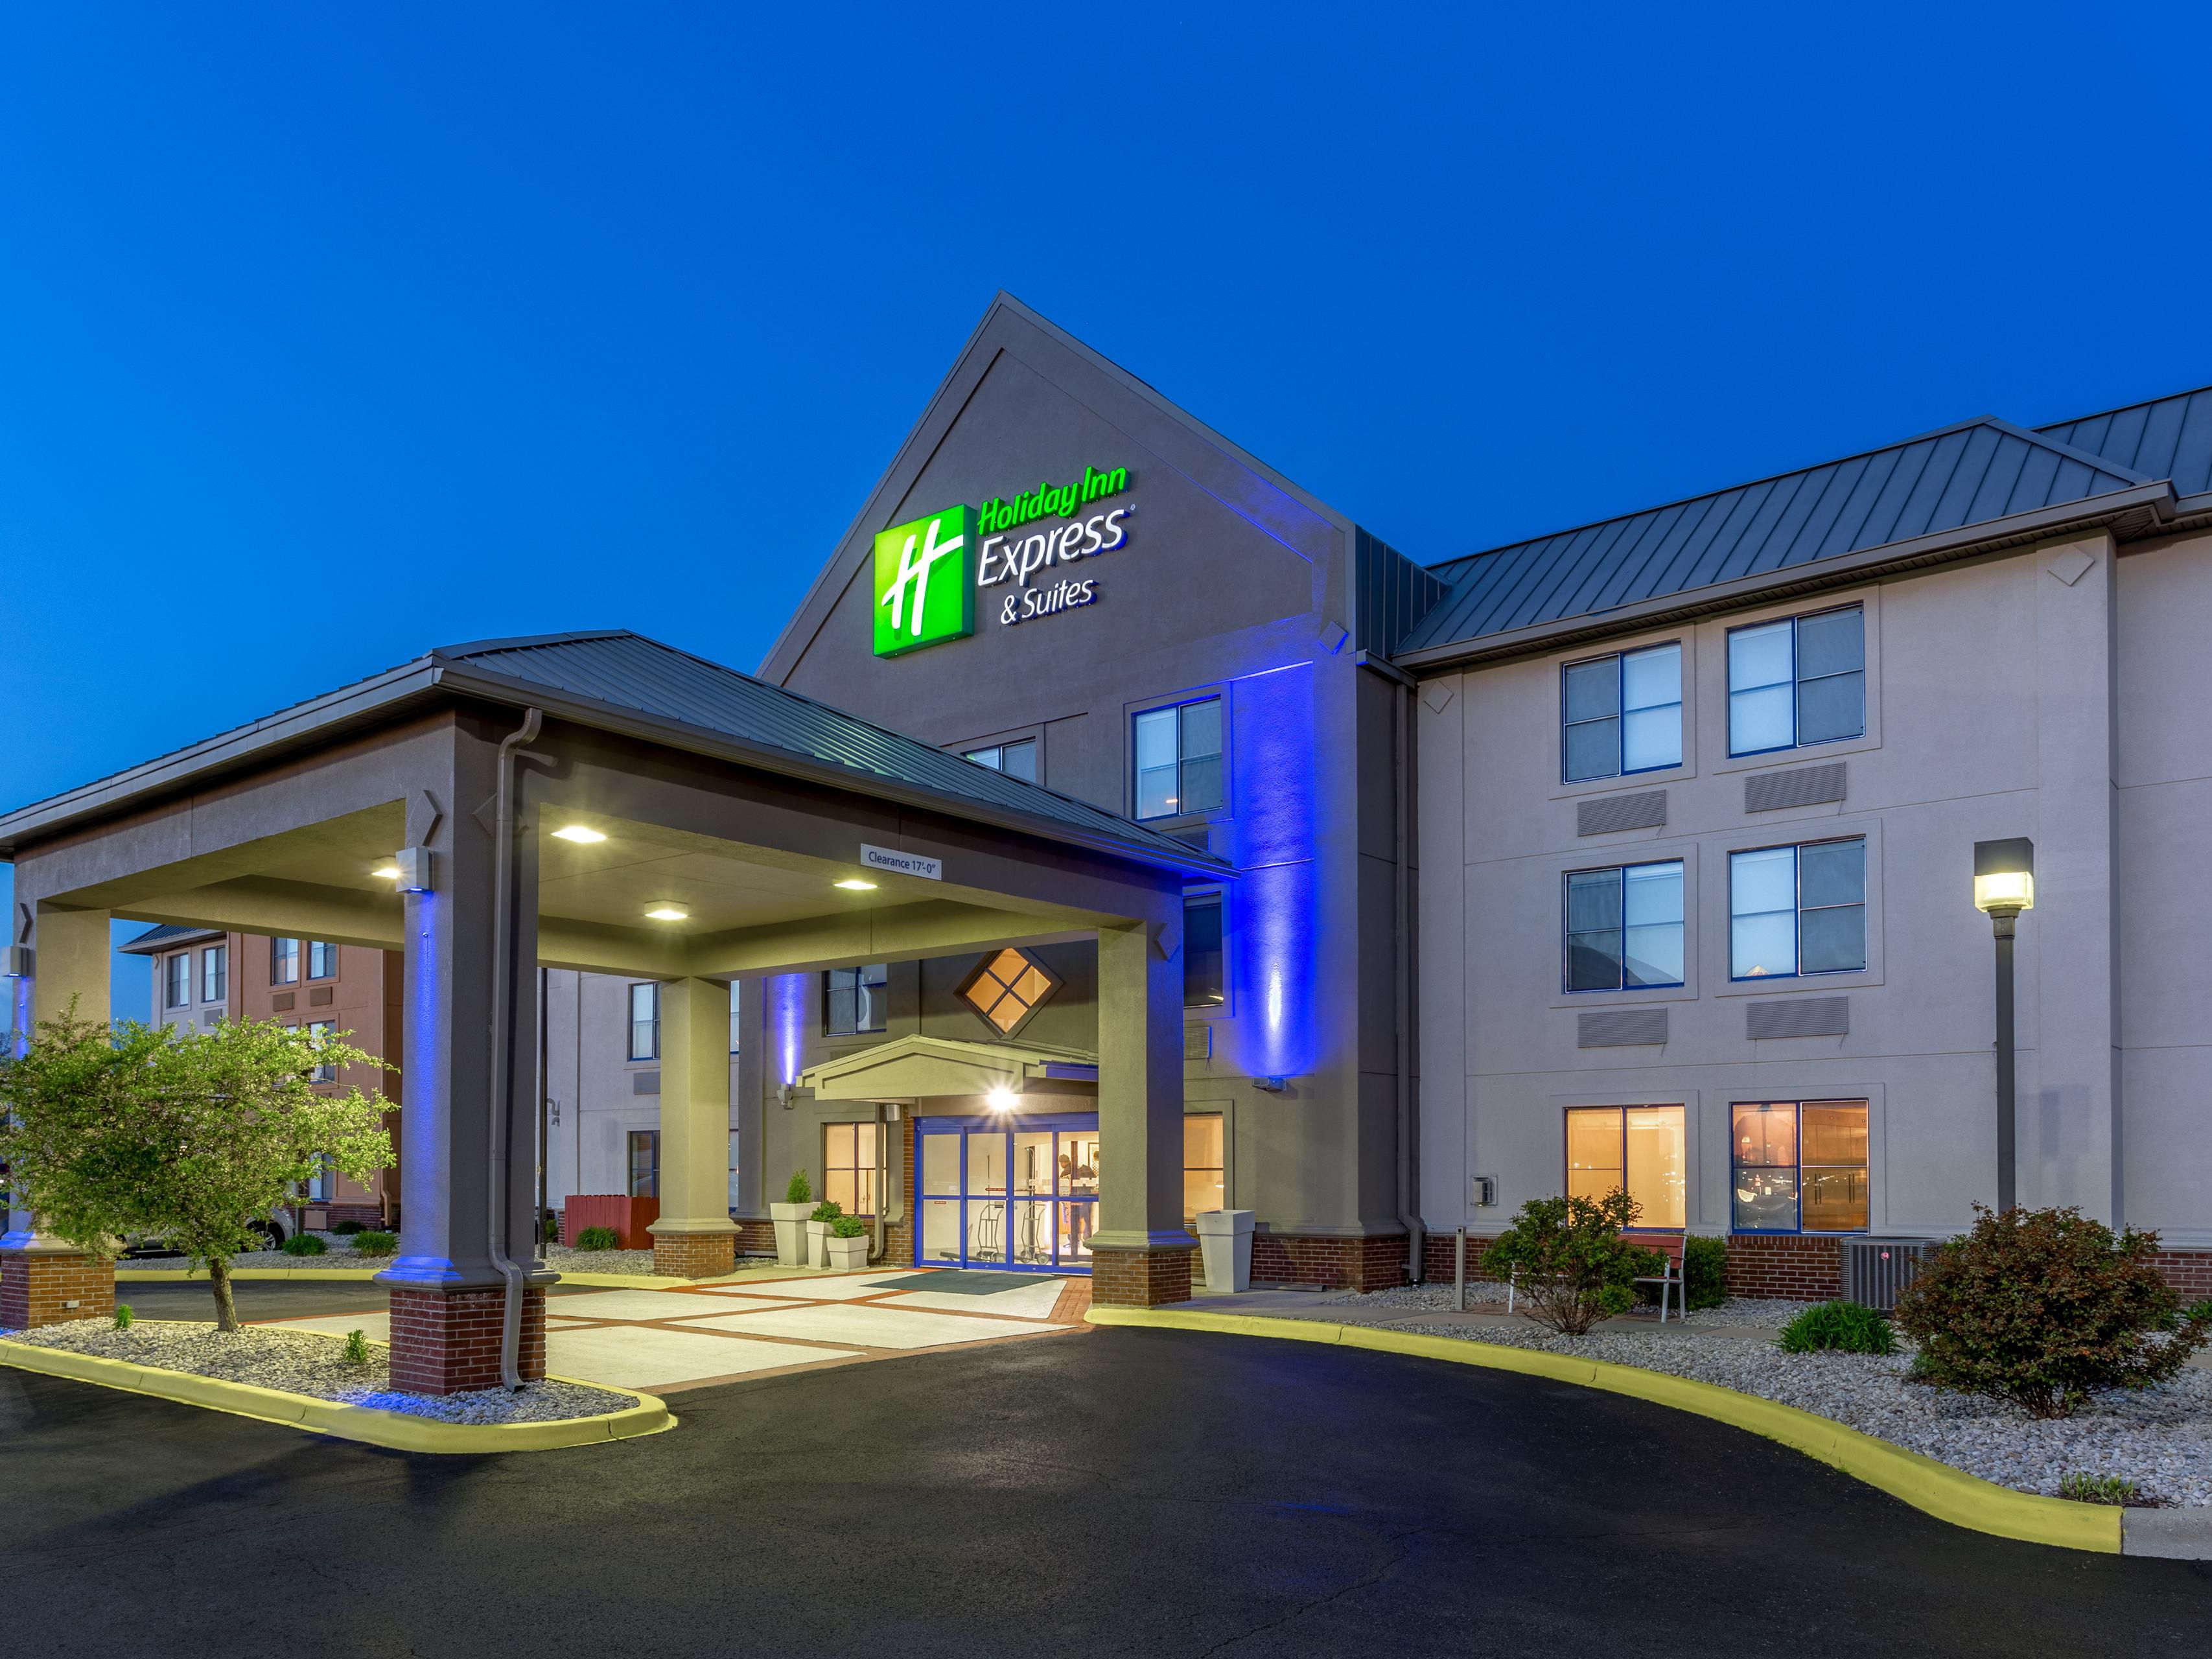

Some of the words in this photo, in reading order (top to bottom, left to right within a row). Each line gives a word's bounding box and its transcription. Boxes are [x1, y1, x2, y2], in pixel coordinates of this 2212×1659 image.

[977, 482, 1081, 536] Holiday
[1082, 466, 1126, 502] Inn
[977, 509, 1125, 586] Express
[1000, 594, 1018, 625] &
[1021, 579, 1094, 618] Suites
[868, 851, 910, 869] Clearance
